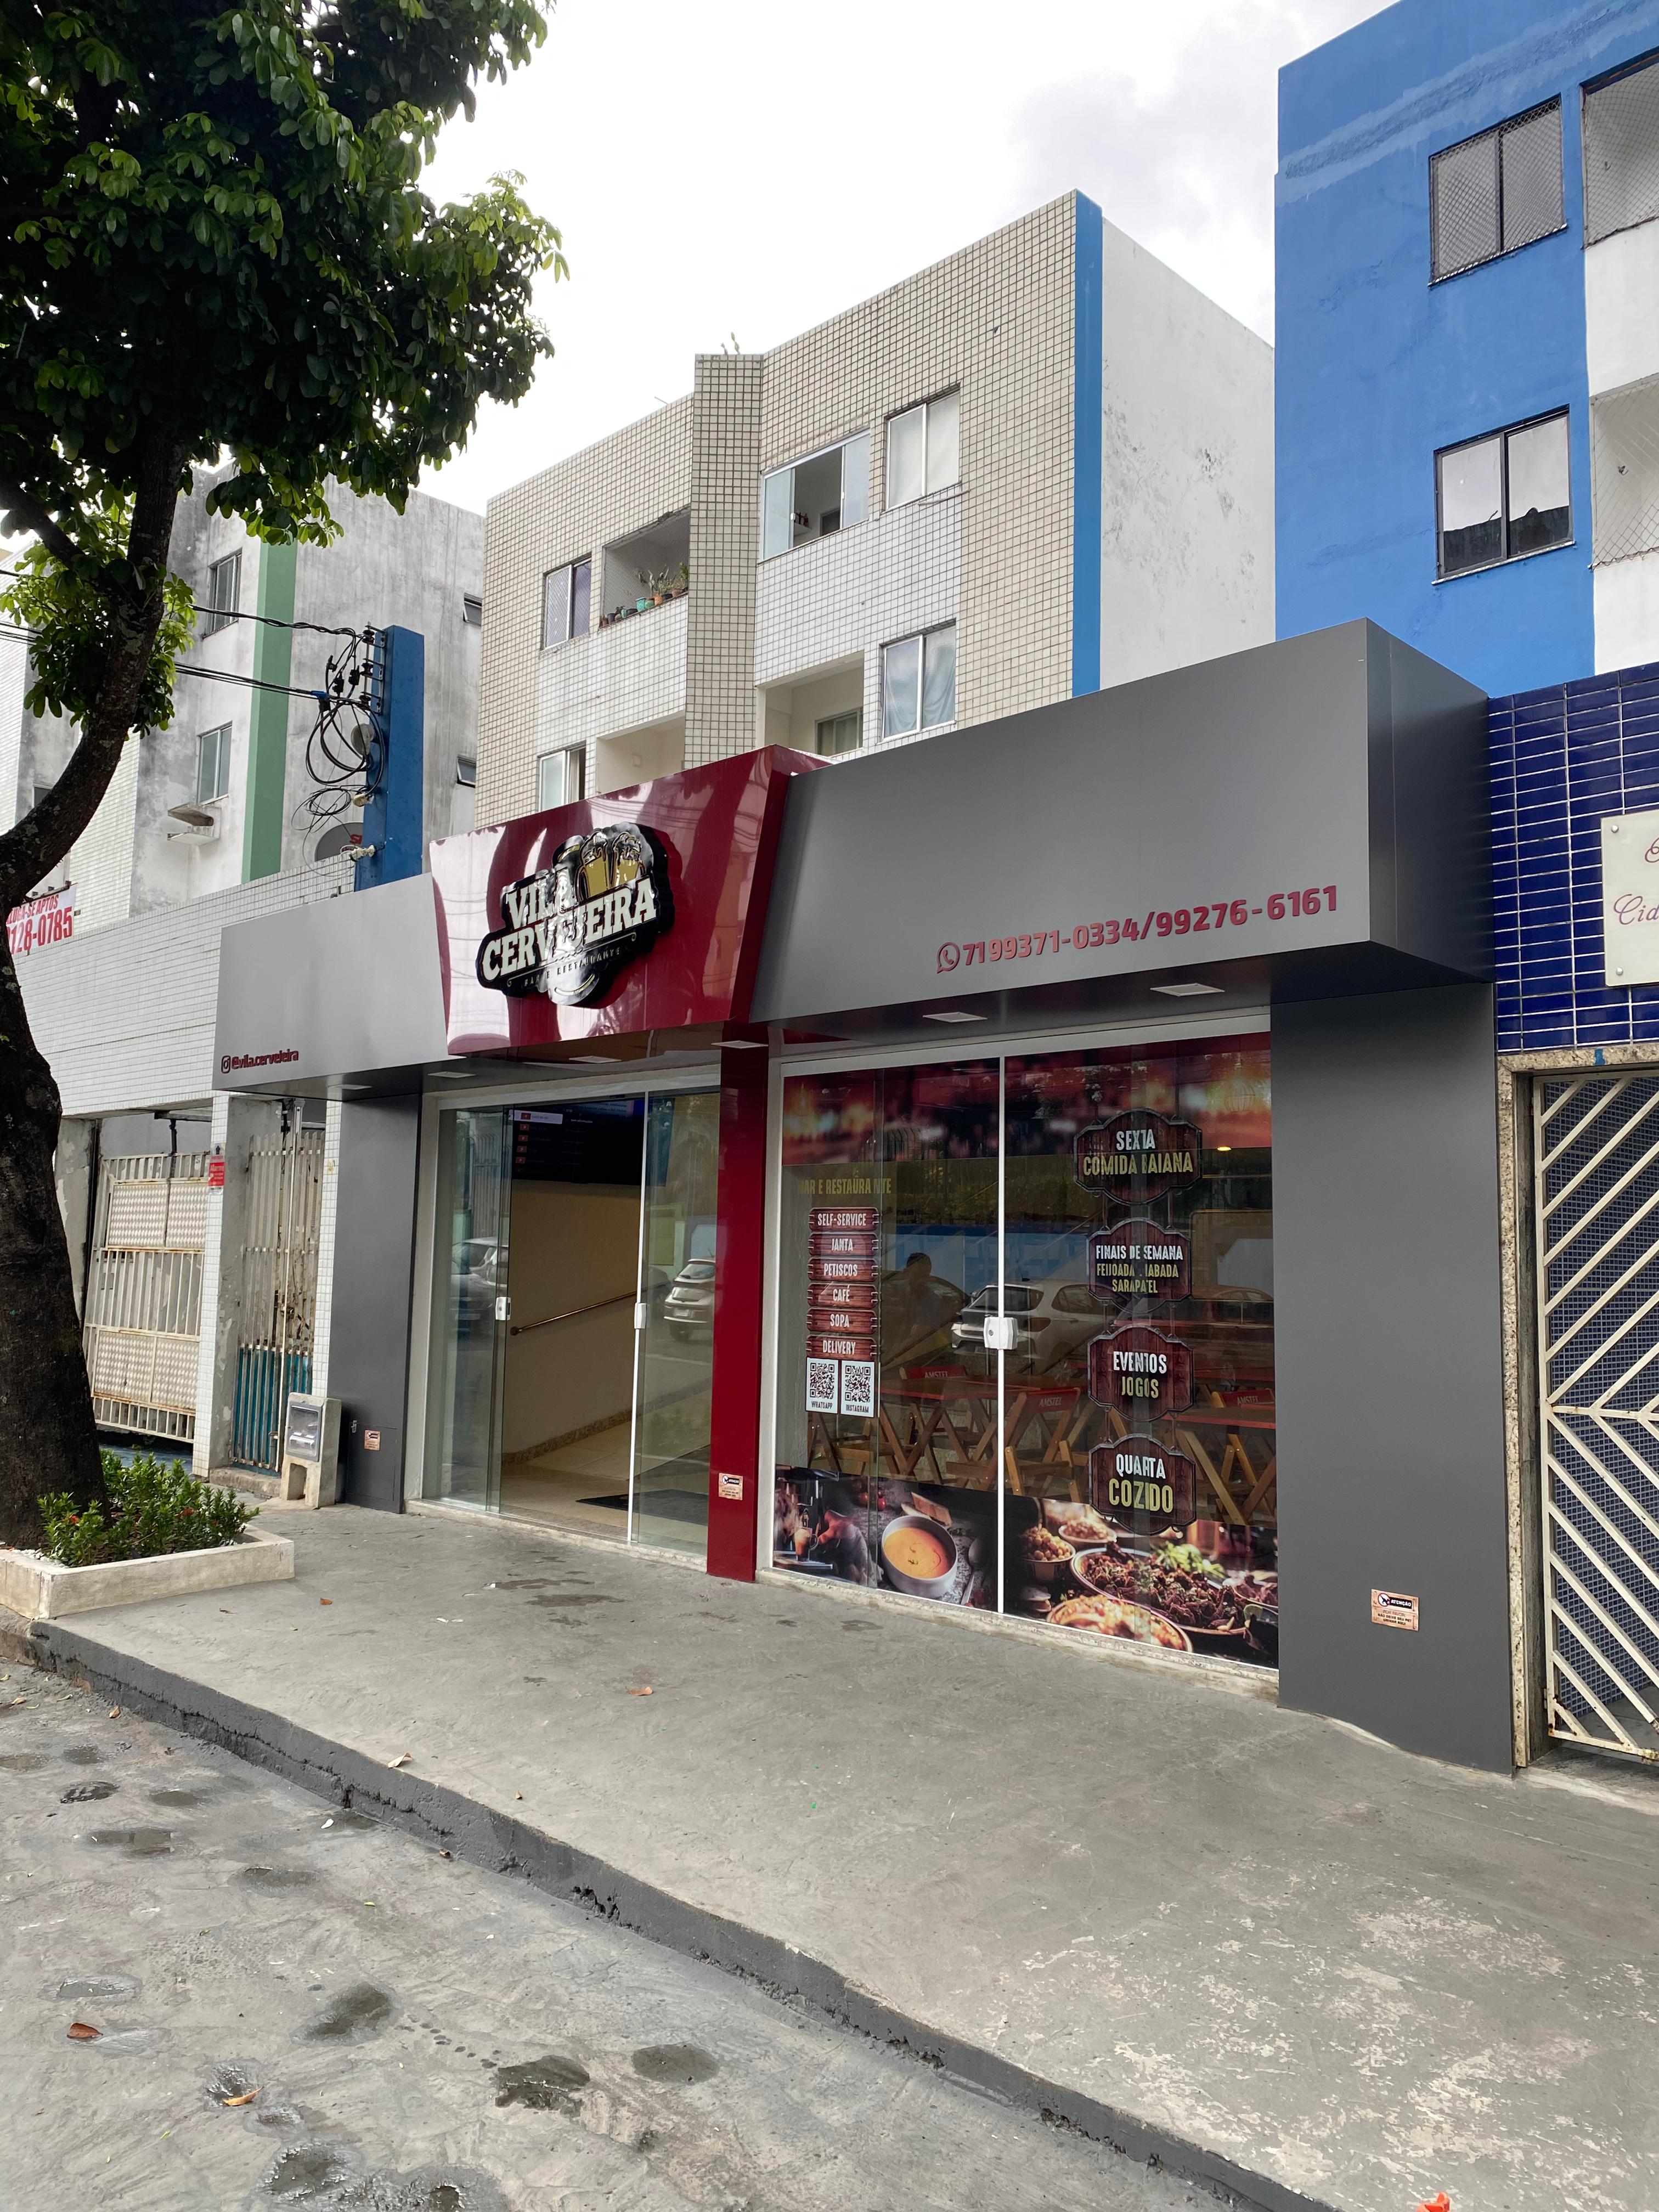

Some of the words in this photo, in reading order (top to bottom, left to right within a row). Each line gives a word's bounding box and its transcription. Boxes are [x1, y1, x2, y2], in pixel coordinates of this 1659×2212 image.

[36, 894, 59, 915] APTOS
[481, 877, 657, 981] CERVEJEIRA
[557, 946, 620, 976] RESTAURANTE
[1116, 1128, 1155, 1151] SEXTA
[1083, 1154, 1137, 1176] COMIDA
[1141, 1152, 1193, 1174] BAIANA
[818, 1179, 823, 1194] E
[817, 1213, 866, 1226] SELF-SERVICE
[831, 1238, 854, 1251] JANTA
[1096, 1245, 1127, 1260] FINAIS
[1130, 1245, 1141, 1260] DE
[1143, 1245, 1183, 1260] SEMANA
[823, 1263, 858, 1277] PETISCOS
[1097, 1263, 1135, 1277] FEIJOADA
[833, 1284, 850, 1302] CAFÉ
[830, 1313, 850, 1328] SOPA
[823, 1340, 856, 1355] DELIVERY
[1113, 1351, 1167, 1374] EVENTOS
[1121, 1376, 1159, 1398] JOGOS
[811, 1401, 833, 1409] WHATSAPP
[845, 1404, 869, 1413] INSTAGRAM
[1039, 1397, 1062, 1407] AMSTEL
[1116, 1453, 1166, 1479] QUARTA
[1109, 1478, 1173, 1513] COZIDO
